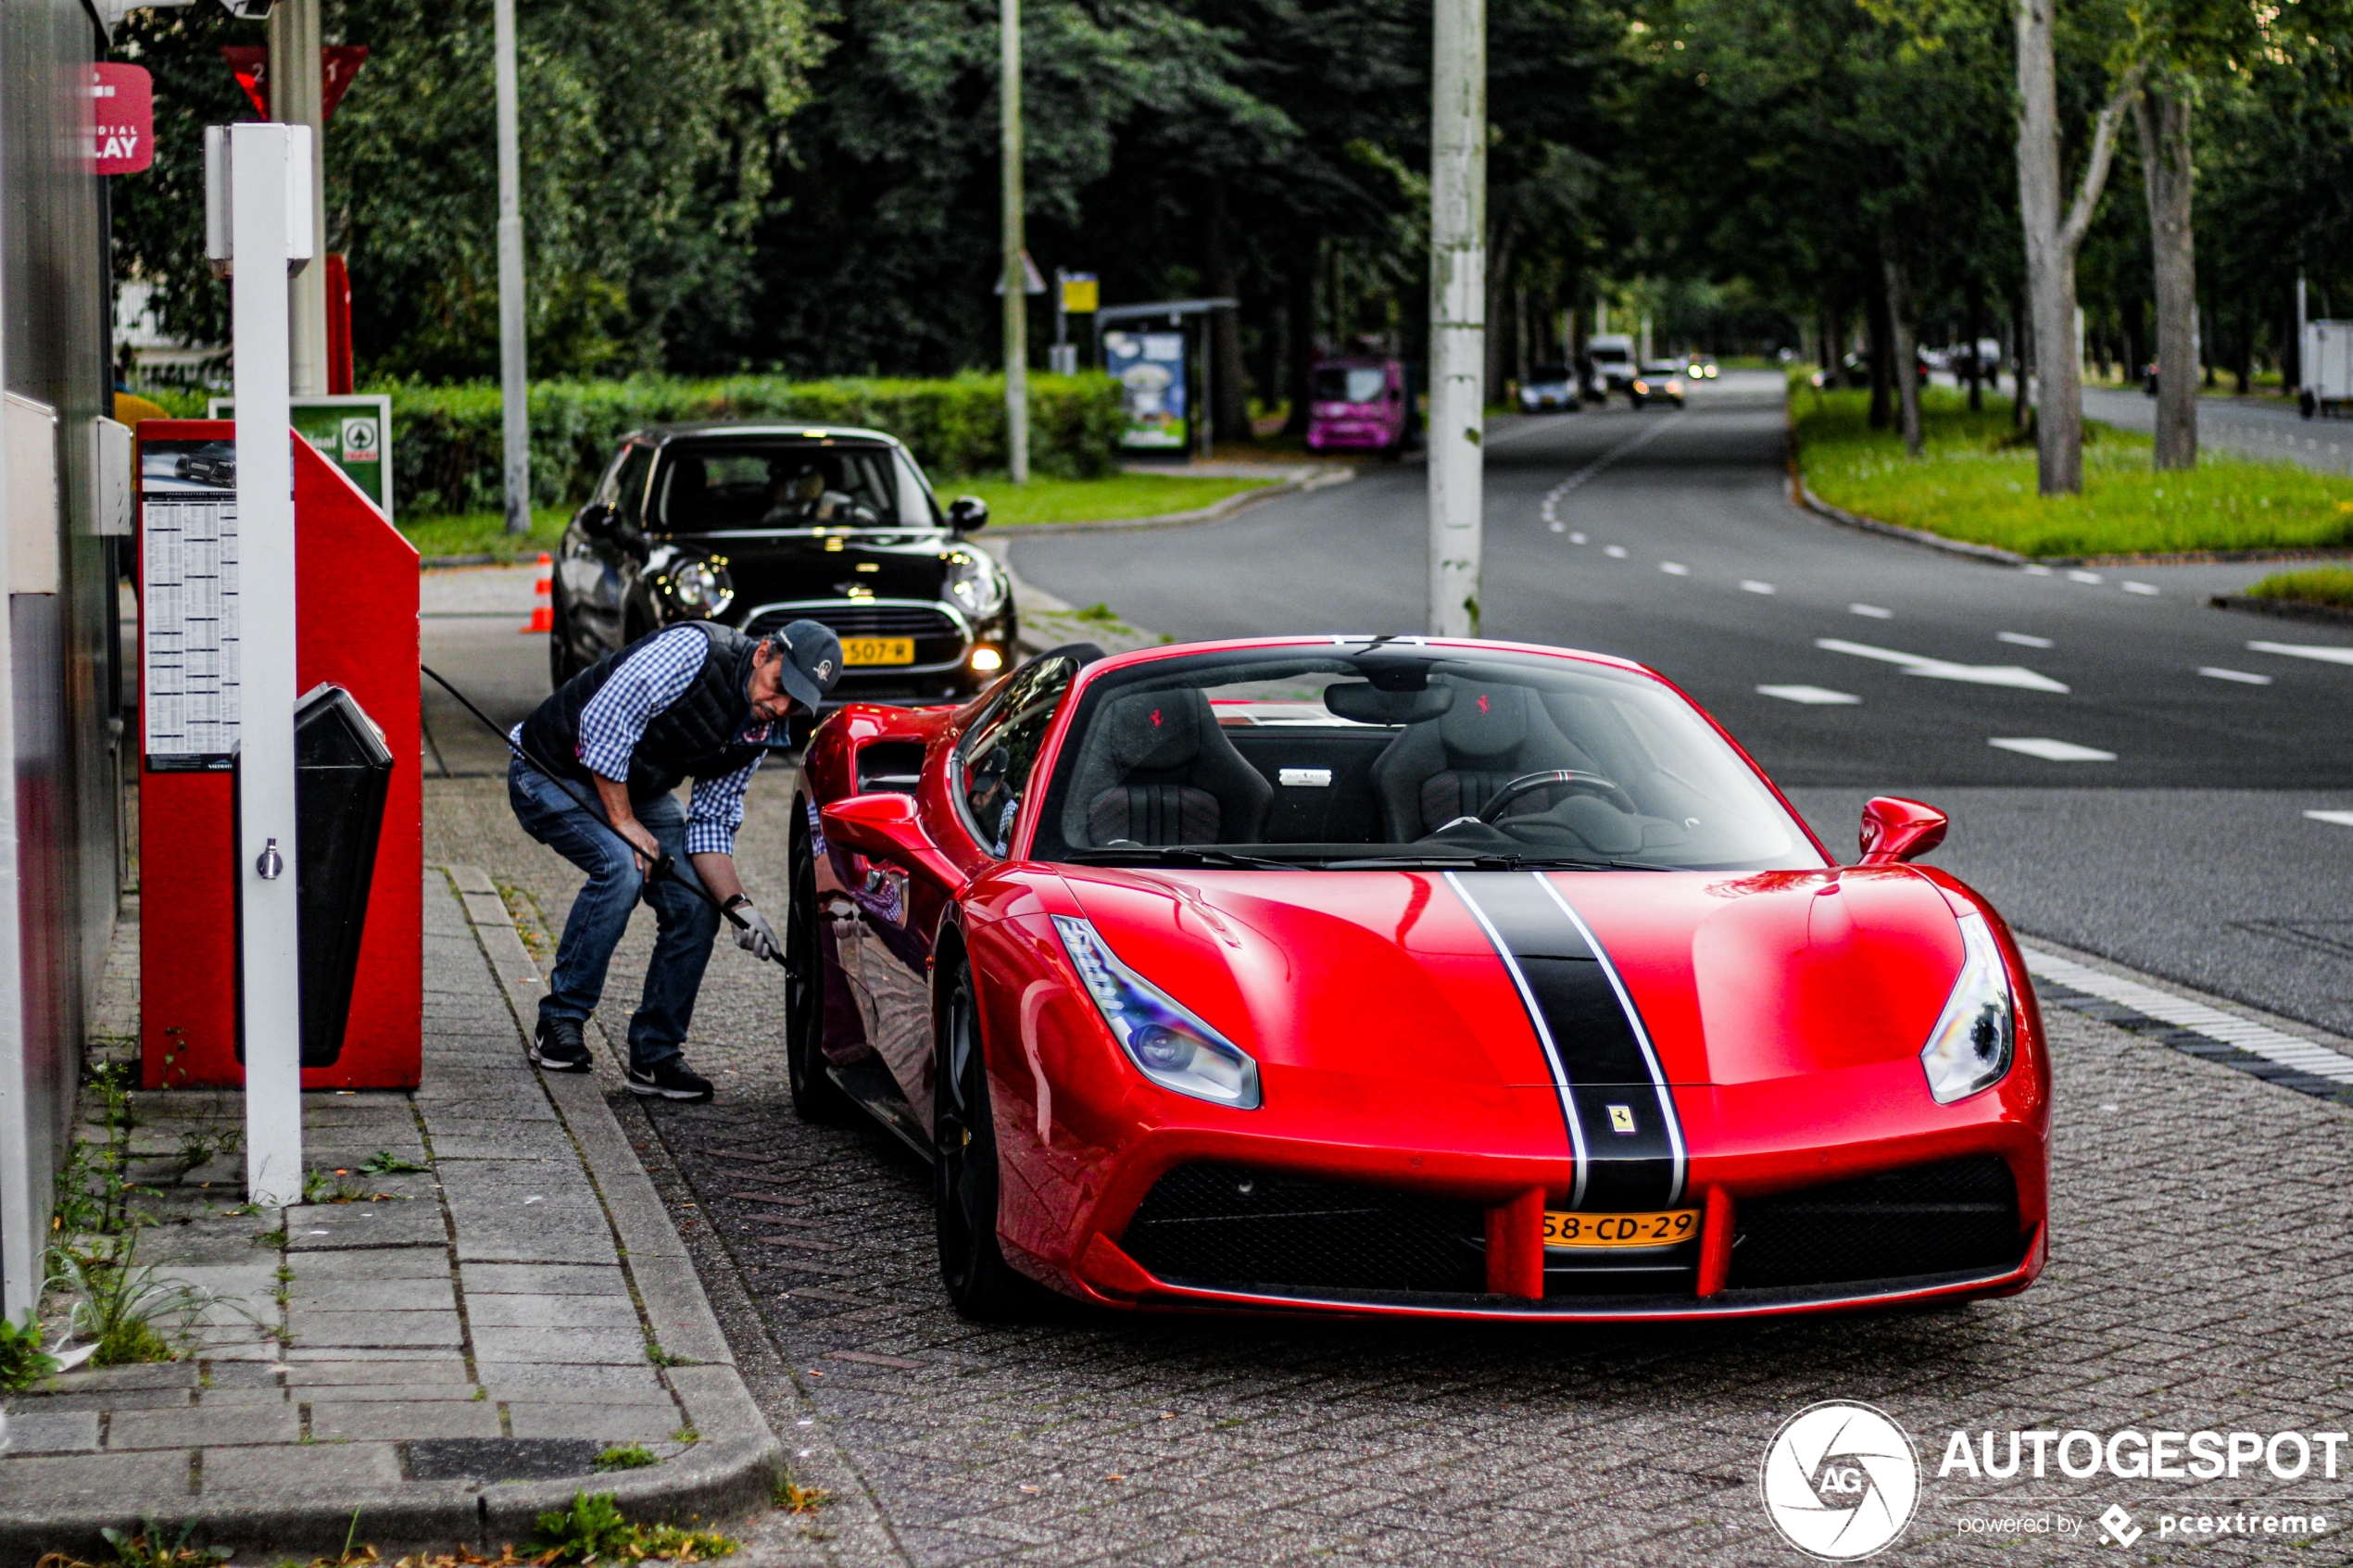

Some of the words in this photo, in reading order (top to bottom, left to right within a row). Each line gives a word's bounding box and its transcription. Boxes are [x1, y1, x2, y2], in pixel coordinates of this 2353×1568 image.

[252, 62, 265, 83] 2
[325, 63, 337, 82] 1
[97, 125, 138, 136] DIAL
[844, 642, 906, 660] -507-R
[1543, 1213, 1692, 1240] 58-CD-29
